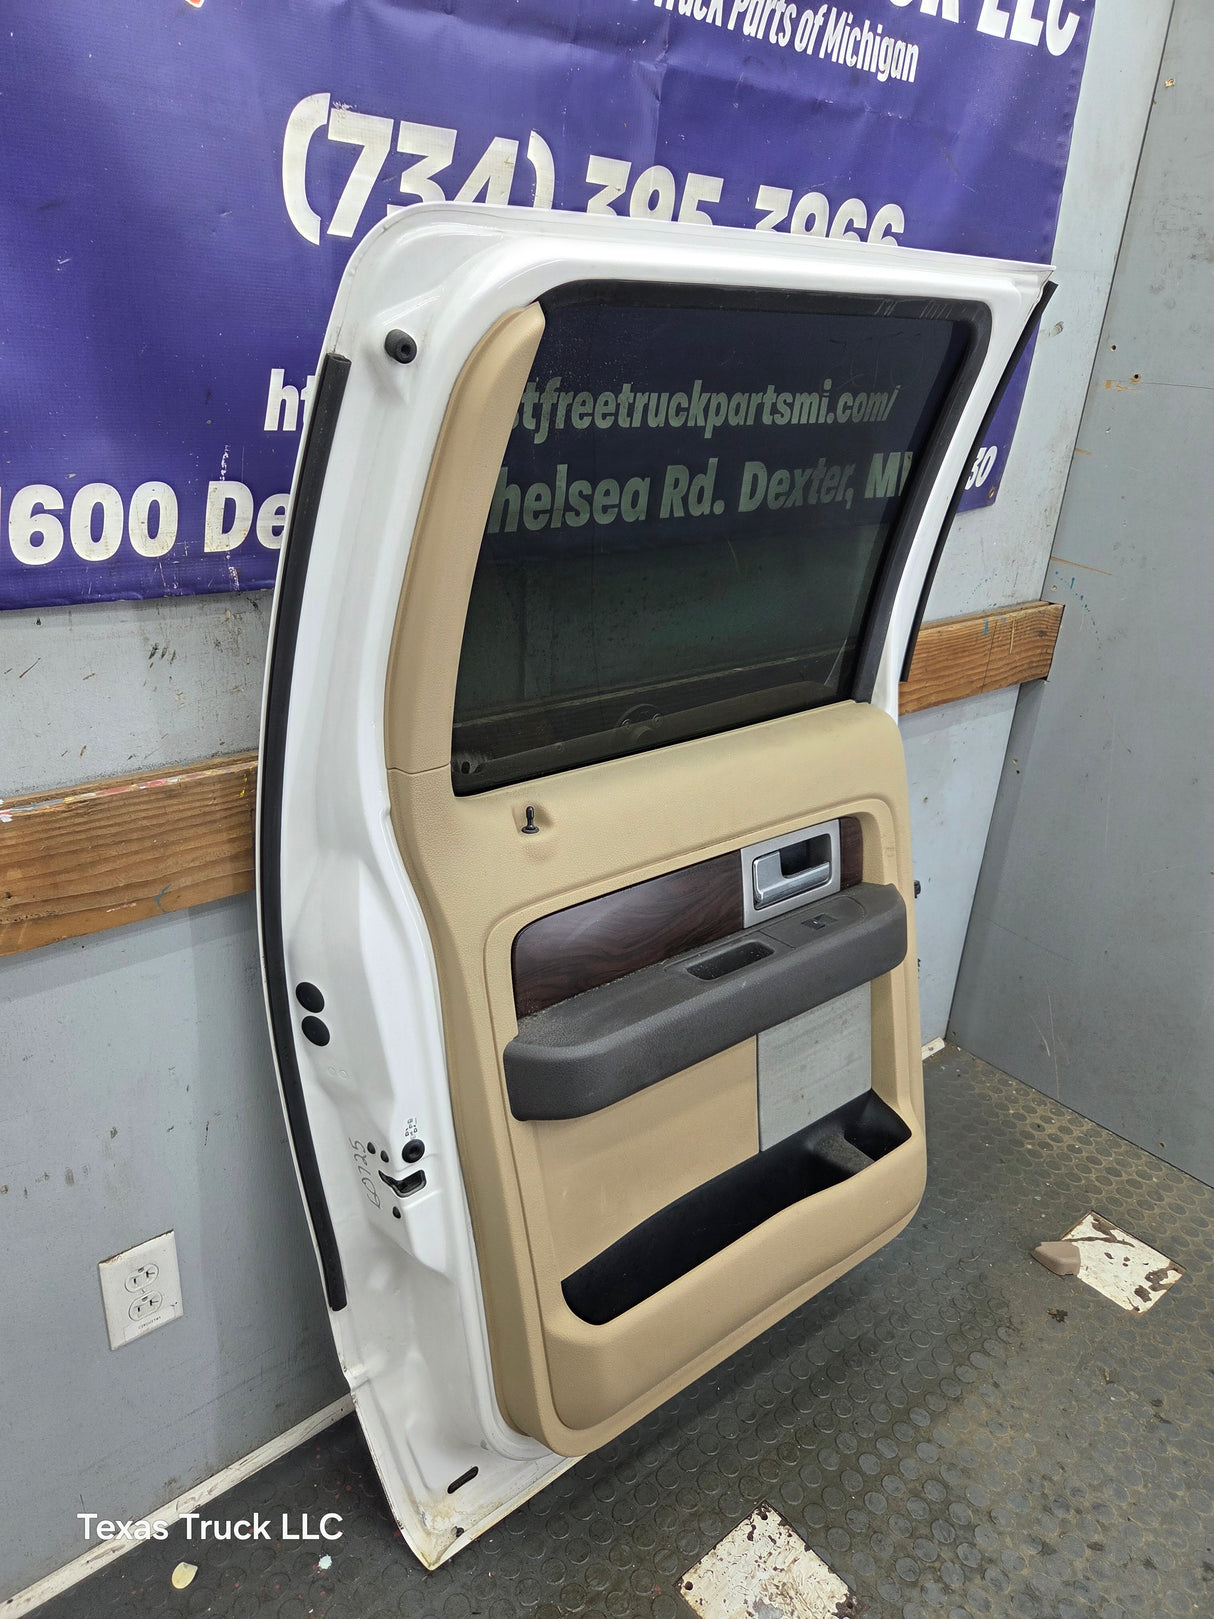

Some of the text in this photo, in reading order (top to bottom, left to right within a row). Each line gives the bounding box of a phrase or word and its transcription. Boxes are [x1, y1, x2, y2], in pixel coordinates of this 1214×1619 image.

[727, 0, 797, 47] Parts
[794, 4, 829, 55] of
[819, 6, 919, 83] Michigan
[512, 376, 902, 445] tfreetruckpartsmi.com/
[0, 480, 179, 566] 600
[659, 457, 725, 519] Rd.
[738, 457, 855, 514] Dexter,
